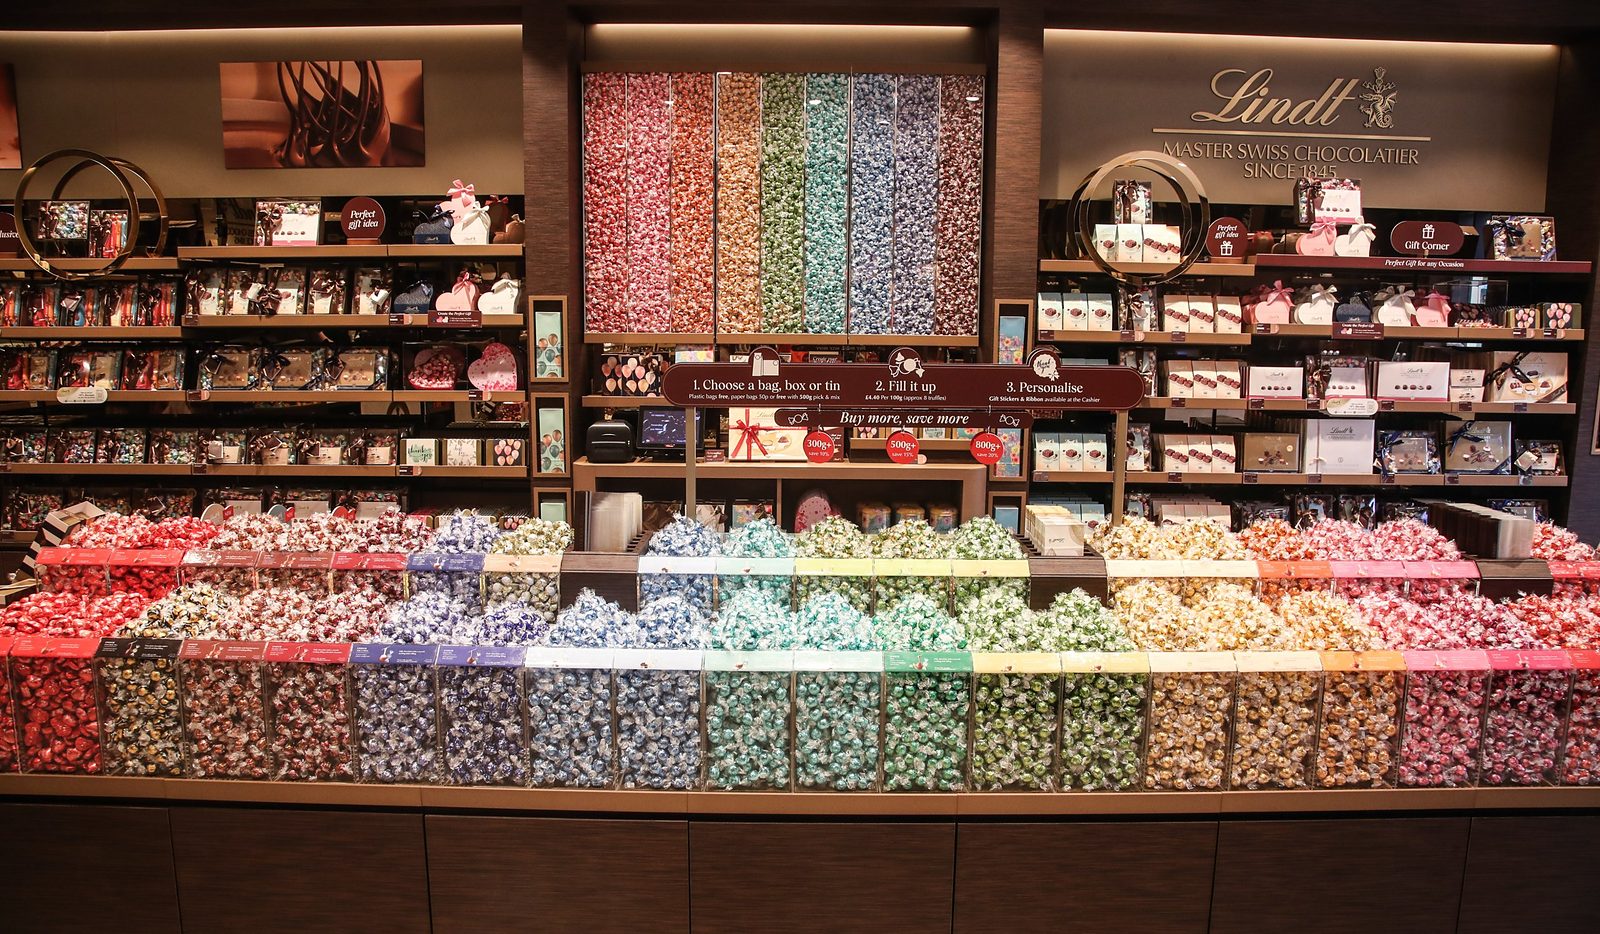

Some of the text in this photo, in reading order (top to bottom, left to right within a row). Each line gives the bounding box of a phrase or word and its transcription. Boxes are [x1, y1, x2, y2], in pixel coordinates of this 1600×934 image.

[1190, 68, 1360, 127] Lindt
[1163, 141, 1419, 165] MASTER SWISS CHOCOLATIER
[1244, 162, 1338, 180] SINCE 1845
[350, 209, 376, 220] Perfect
[347, 219, 379, 230] gift idea
[1217, 224, 1238, 232] Perfect
[1214, 231, 1226, 239] gift
[1404, 240, 1450, 251] Gift Corner
[1384, 259, 1405, 267] Perfect
[1405, 259, 1417, 268] Gift
[1438, 260, 1464, 268] Occasion
[693, 379, 841, 393] 1. Choose a bag, box or tin
[875, 380, 937, 394] 2. Fill it up
[1006, 382, 1084, 393] 3. Personalise
[746, 393, 758, 401] bags
[840, 412, 969, 426] Buy more, save more
[807, 440, 832, 450] 300g+
[890, 440, 916, 452] 500g+
[975, 441, 1001, 452] 800g+
